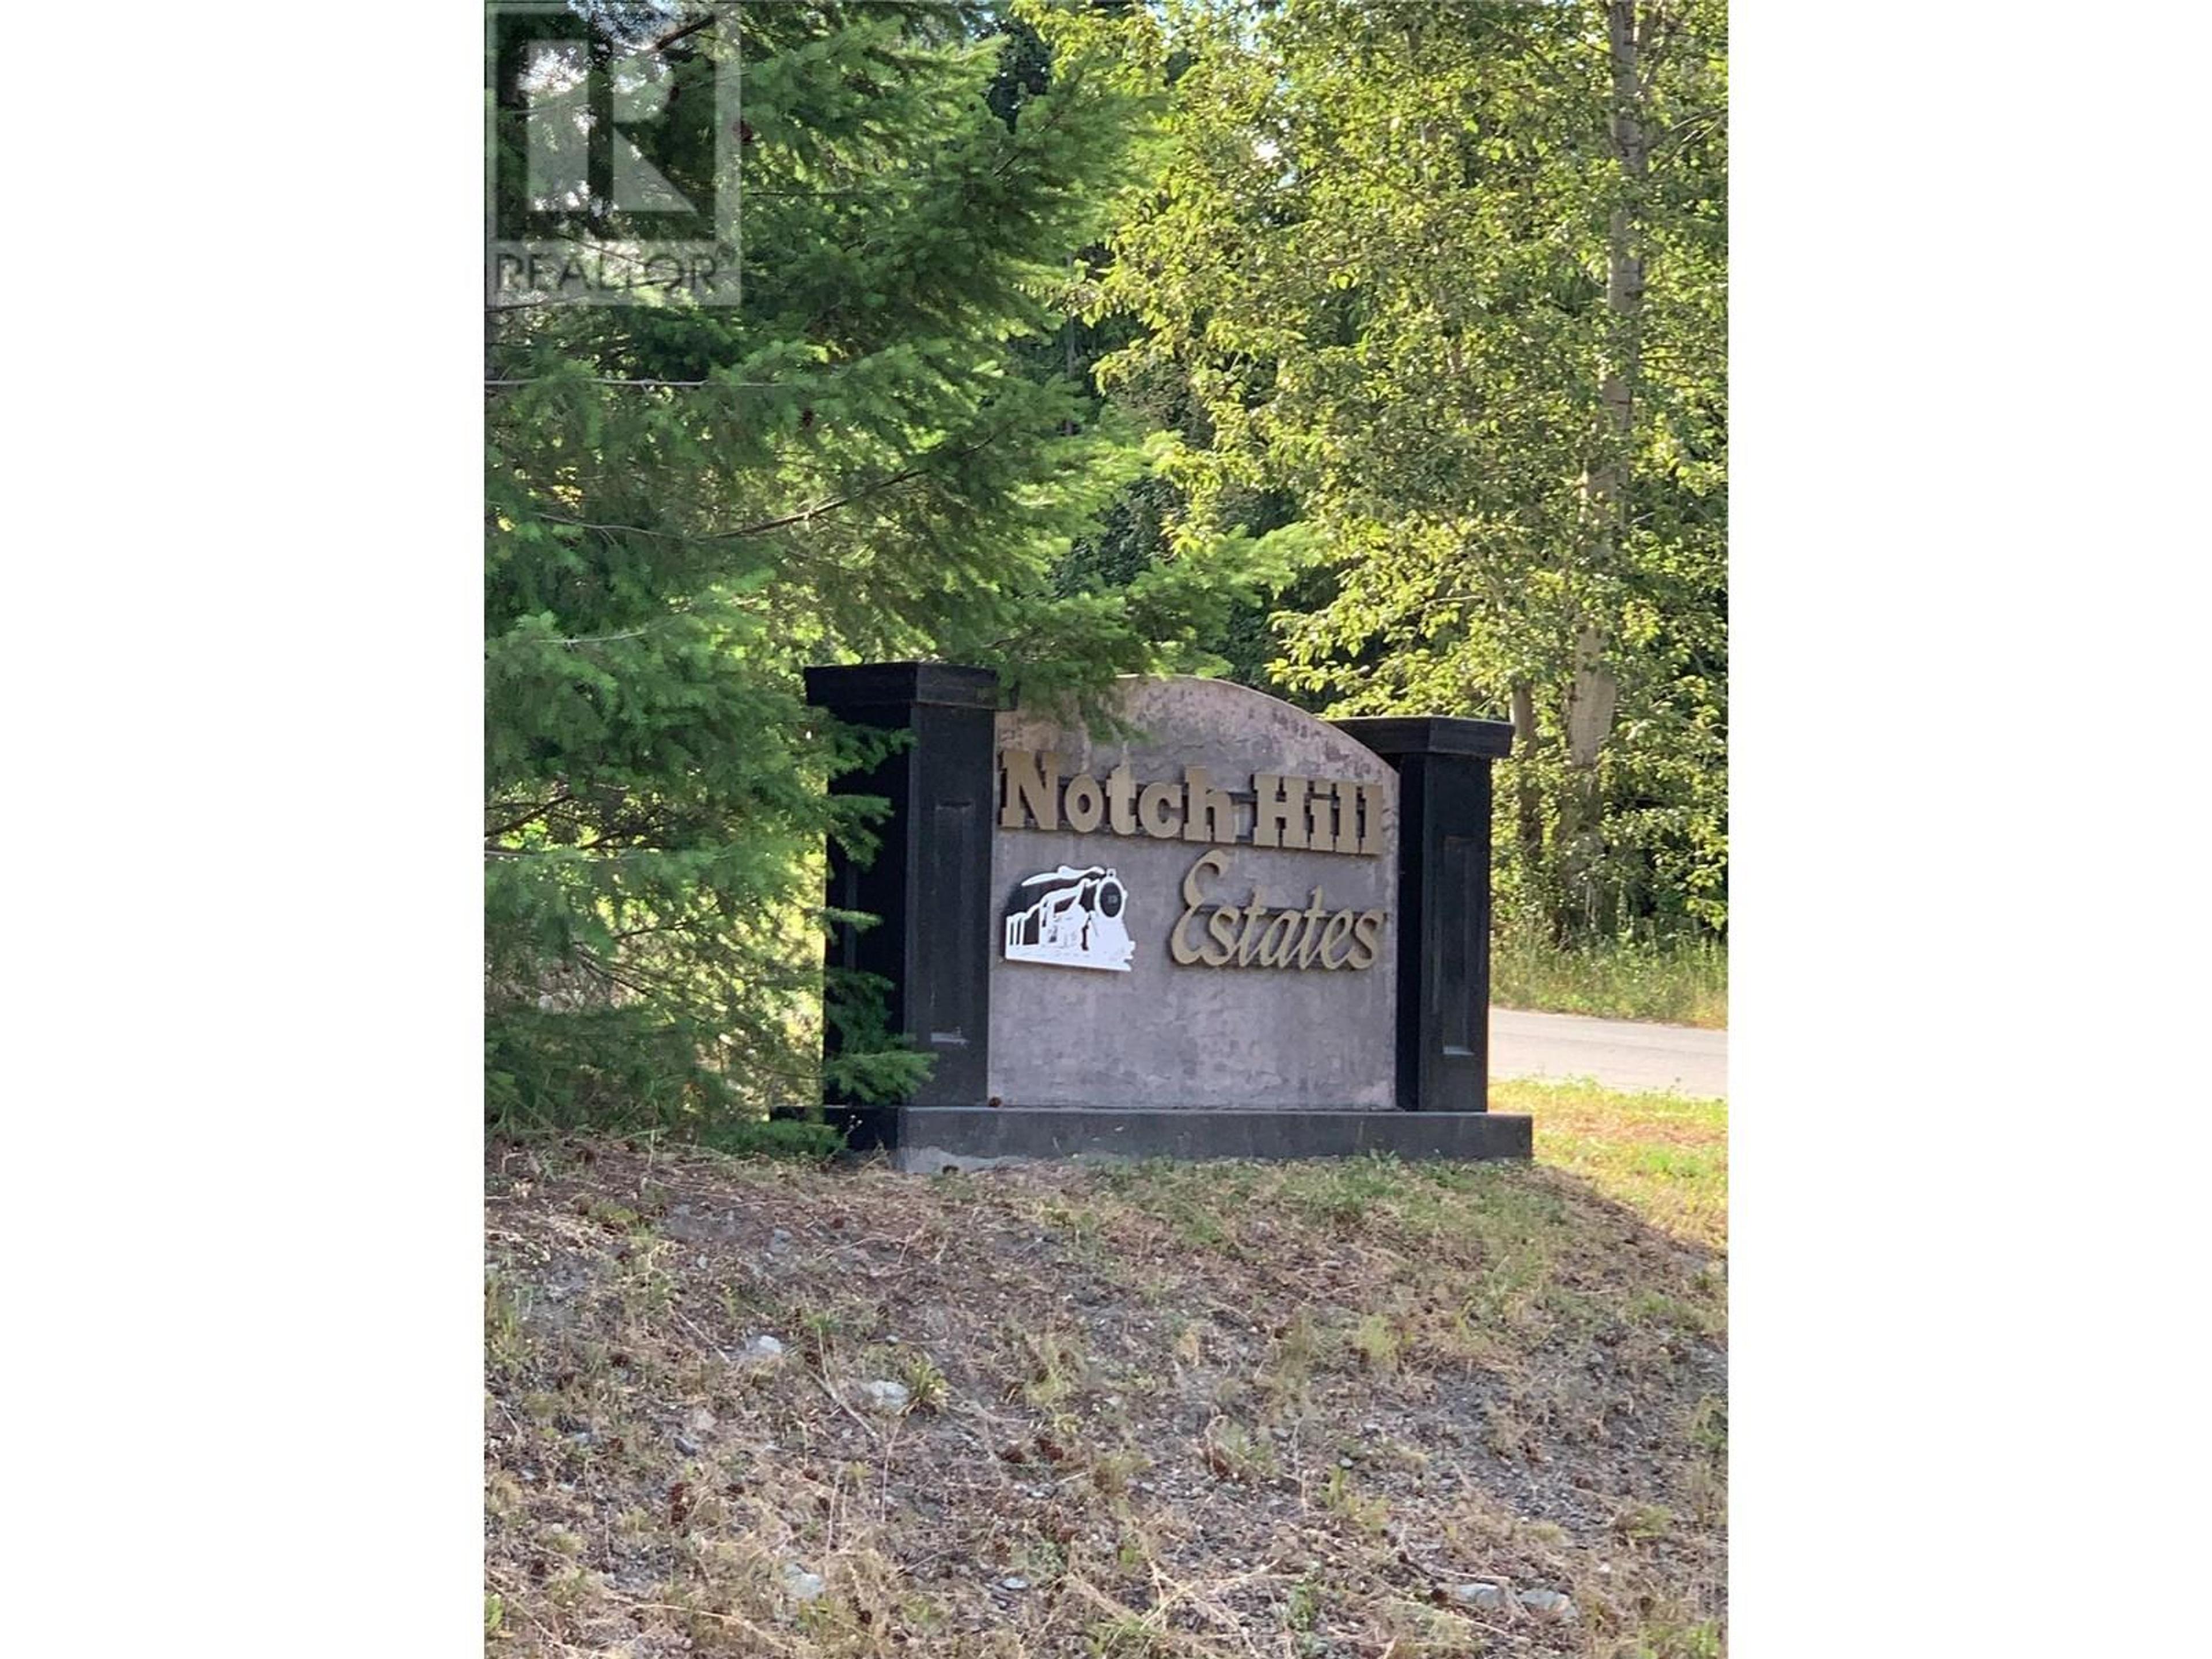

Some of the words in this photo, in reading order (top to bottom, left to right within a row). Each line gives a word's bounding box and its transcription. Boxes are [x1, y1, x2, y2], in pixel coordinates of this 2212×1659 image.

[1000, 749, 1237, 843] Notch
[1251, 774, 1383, 855] Hill
[1171, 850, 1384, 970] Estates
